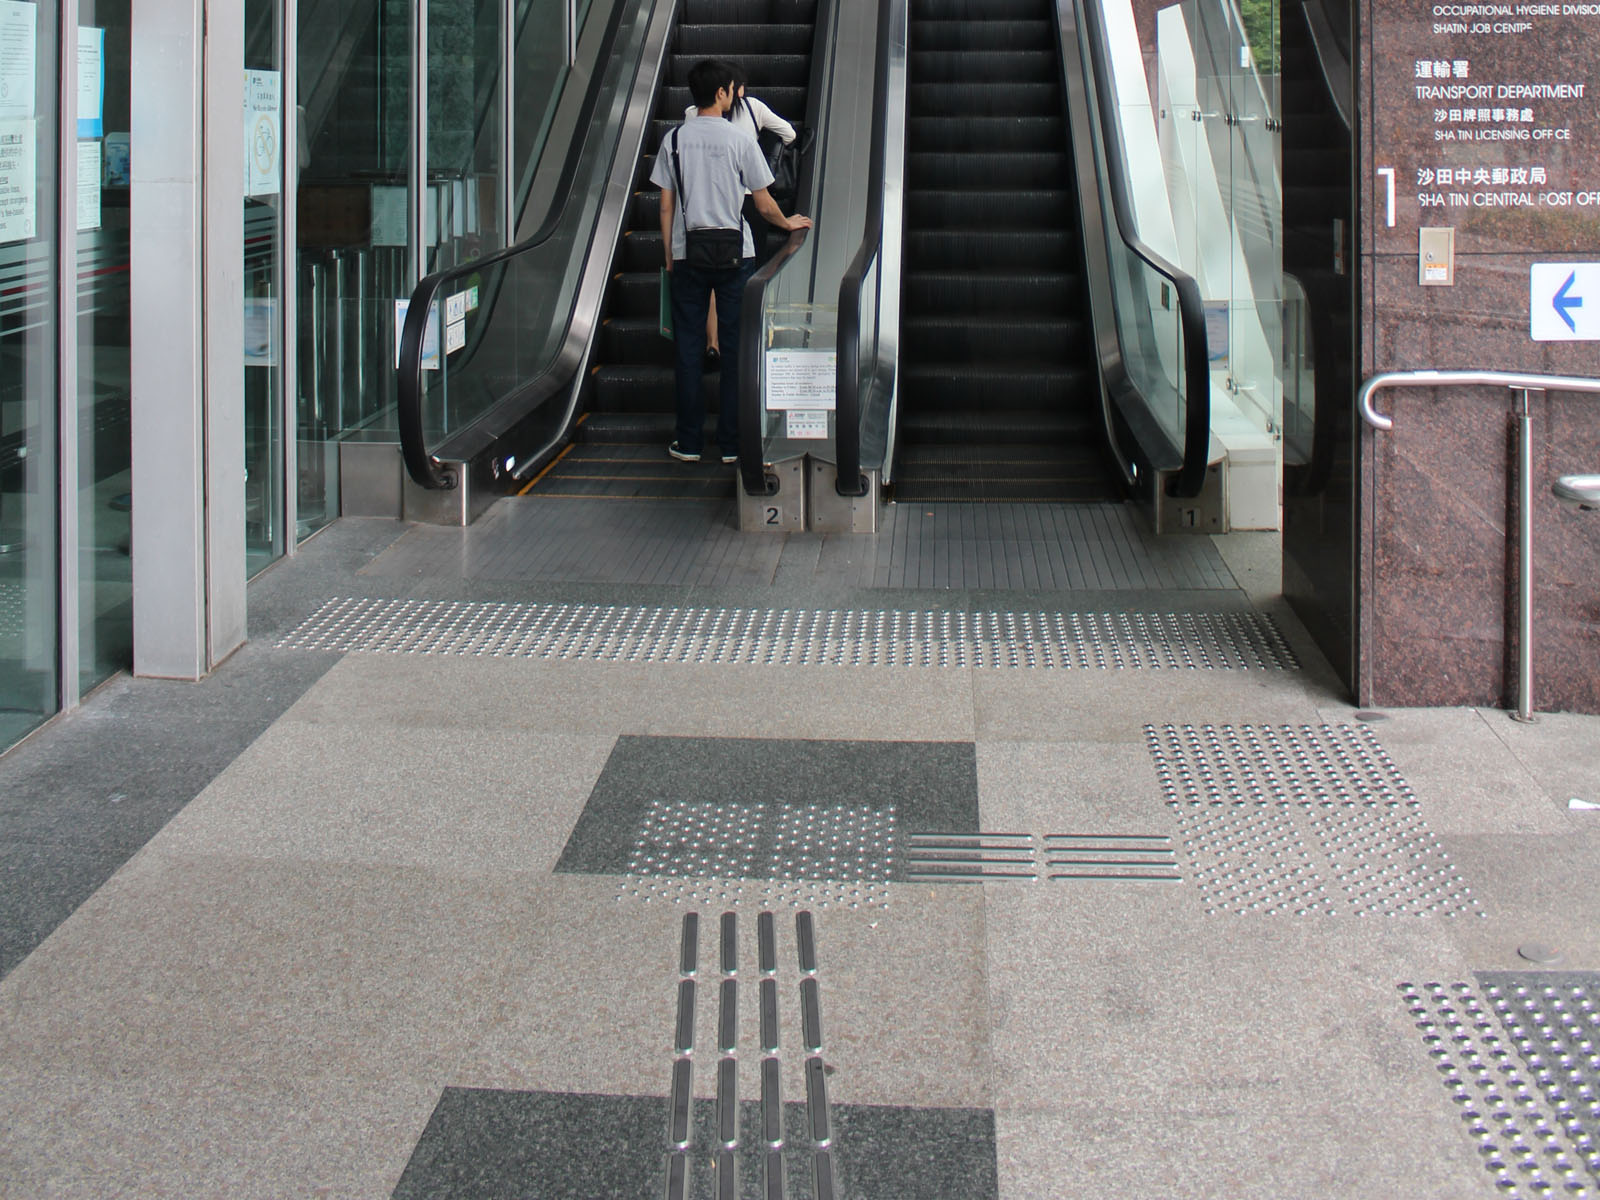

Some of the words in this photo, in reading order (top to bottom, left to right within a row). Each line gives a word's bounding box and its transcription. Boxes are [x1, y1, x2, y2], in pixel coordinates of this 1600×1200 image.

[1433, 6, 1514, 16] OCCUPATIONAL
[1517, 6, 1560, 16] HYGIENE
[1563, 6, 1600, 16] DIVISIO
[1433, 23, 1468, 34] SHATIN
[1470, 23, 1490, 34] JOB
[1415, 61, 1469, 78] 運輸署
[1416, 85, 1493, 98] TRANSPORT
[1498, 85, 1584, 98] DEPARTMENT
[1434, 109, 1534, 122] 沙田牌照事務處
[1435, 130, 1455, 141] SHA
[1458, 130, 1472, 141] TIN
[1475, 130, 1529, 141] LICENSING
[1532, 130, 1570, 141] OFFCE
[1417, 168, 1547, 185] 沙田中央郵政局
[1378, 168, 1396, 227] 1
[1418, 193, 1445, 206] SHA
[1450, 193, 1469, 206] TIN
[1473, 193, 1534, 206] CENTRAL
[1539, 193, 1573, 206] POST
[766, 507, 779, 525] 2
[1187, 510, 1195, 526] 1
